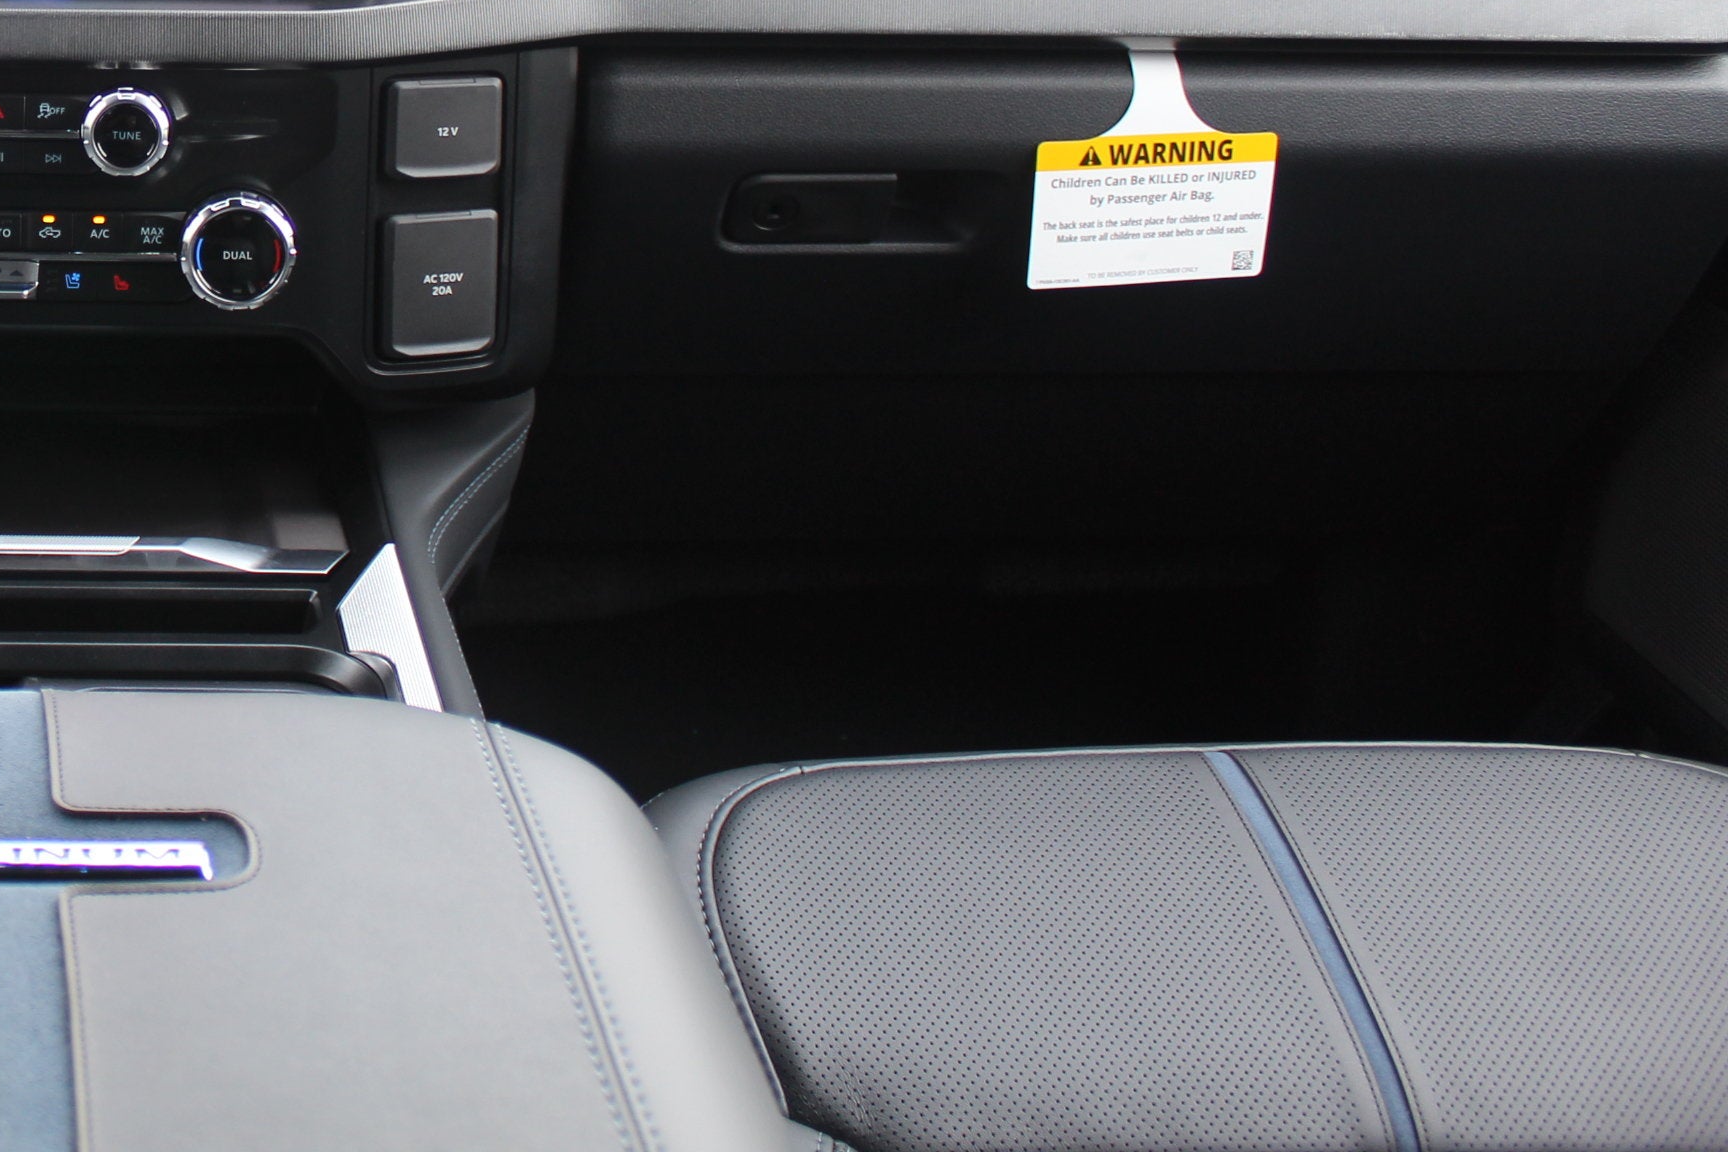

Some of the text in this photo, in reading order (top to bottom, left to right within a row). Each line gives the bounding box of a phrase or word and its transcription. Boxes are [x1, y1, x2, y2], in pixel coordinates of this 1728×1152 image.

[49, 106, 66, 115] OFF
[112, 130, 142, 141] TUNE
[437, 126, 459, 137] 12 V
[1109, 139, 1234, 166] WARNING
[1051, 170, 1257, 189] Children Can Be KILLED or INJURED
[1089, 190, 1215, 208] by Passenger Air Bag.
[1043, 222, 1057, 231] The
[1058, 221, 1076, 230] back
[1079, 221, 1095, 229] seat
[1105, 219, 1118, 228] the
[1120, 217, 1143, 227] safest
[1144, 217, 1164, 227] place
[1166, 215, 1177, 225] for
[1179, 214, 1210, 224] children
[1213, 213, 1222, 222] 12
[1223, 212, 1238, 222] and
[90, 228, 110, 240] A/C
[141, 226, 165, 236] MAX
[1056, 234, 1078, 243] Make
[1080, 234, 1097, 242] sure
[1110, 231, 1140, 241] children
[1142, 231, 1156, 239] use
[1157, 229, 1174, 238] seat
[1175, 227, 1194, 237] belts
[1206, 226, 1224, 236] child
[143, 235, 163, 245] A/C
[222, 250, 253, 261] DUAL
[423, 272, 464, 284] AC 120V
[432, 285, 453, 296] 20A
